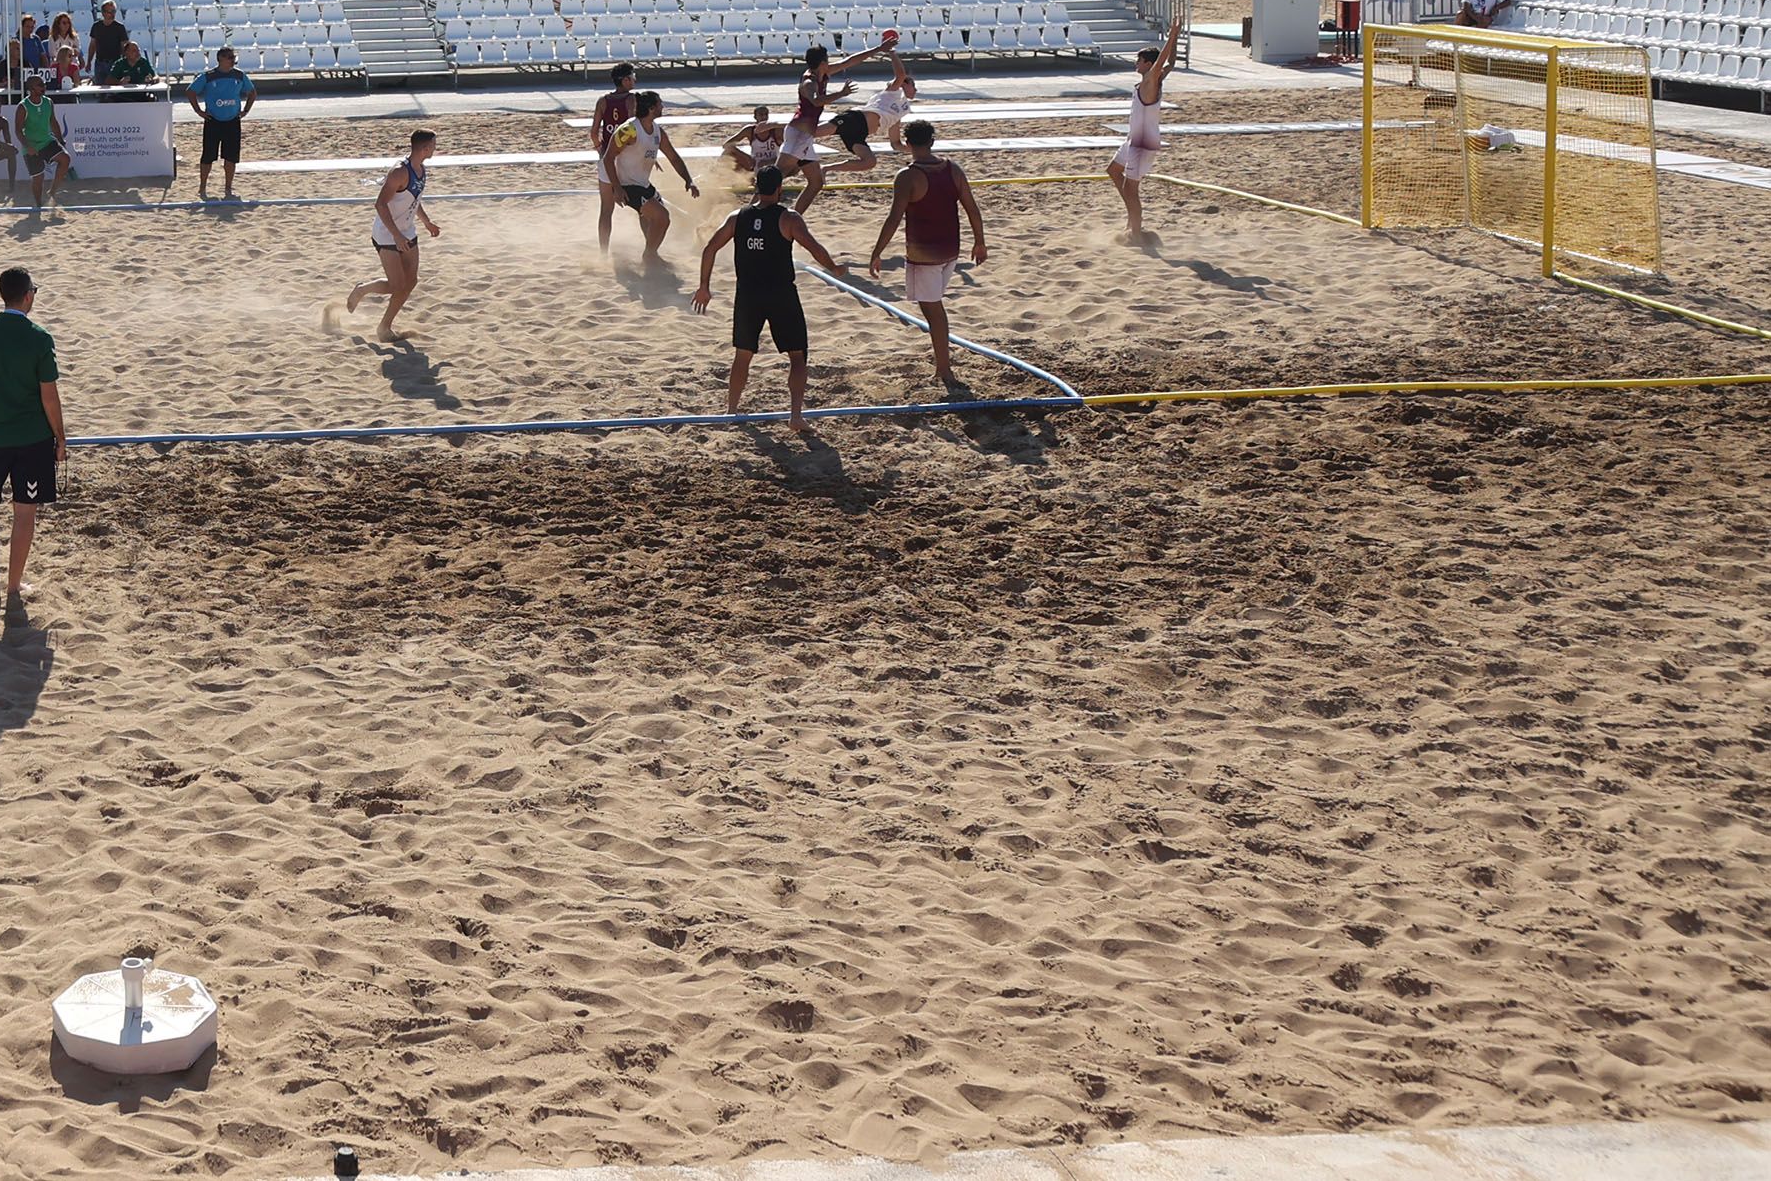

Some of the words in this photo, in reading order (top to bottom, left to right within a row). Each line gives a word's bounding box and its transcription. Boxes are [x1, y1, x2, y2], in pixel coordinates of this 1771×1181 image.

[612, 108, 619, 121] 6
[74, 127, 121, 135] HERAKLION
[122, 126, 141, 134] 2022
[75, 149, 96, 157] World
[96, 149, 150, 157] Championships
[753, 218, 762, 231] 8
[746, 237, 765, 250] GRE
